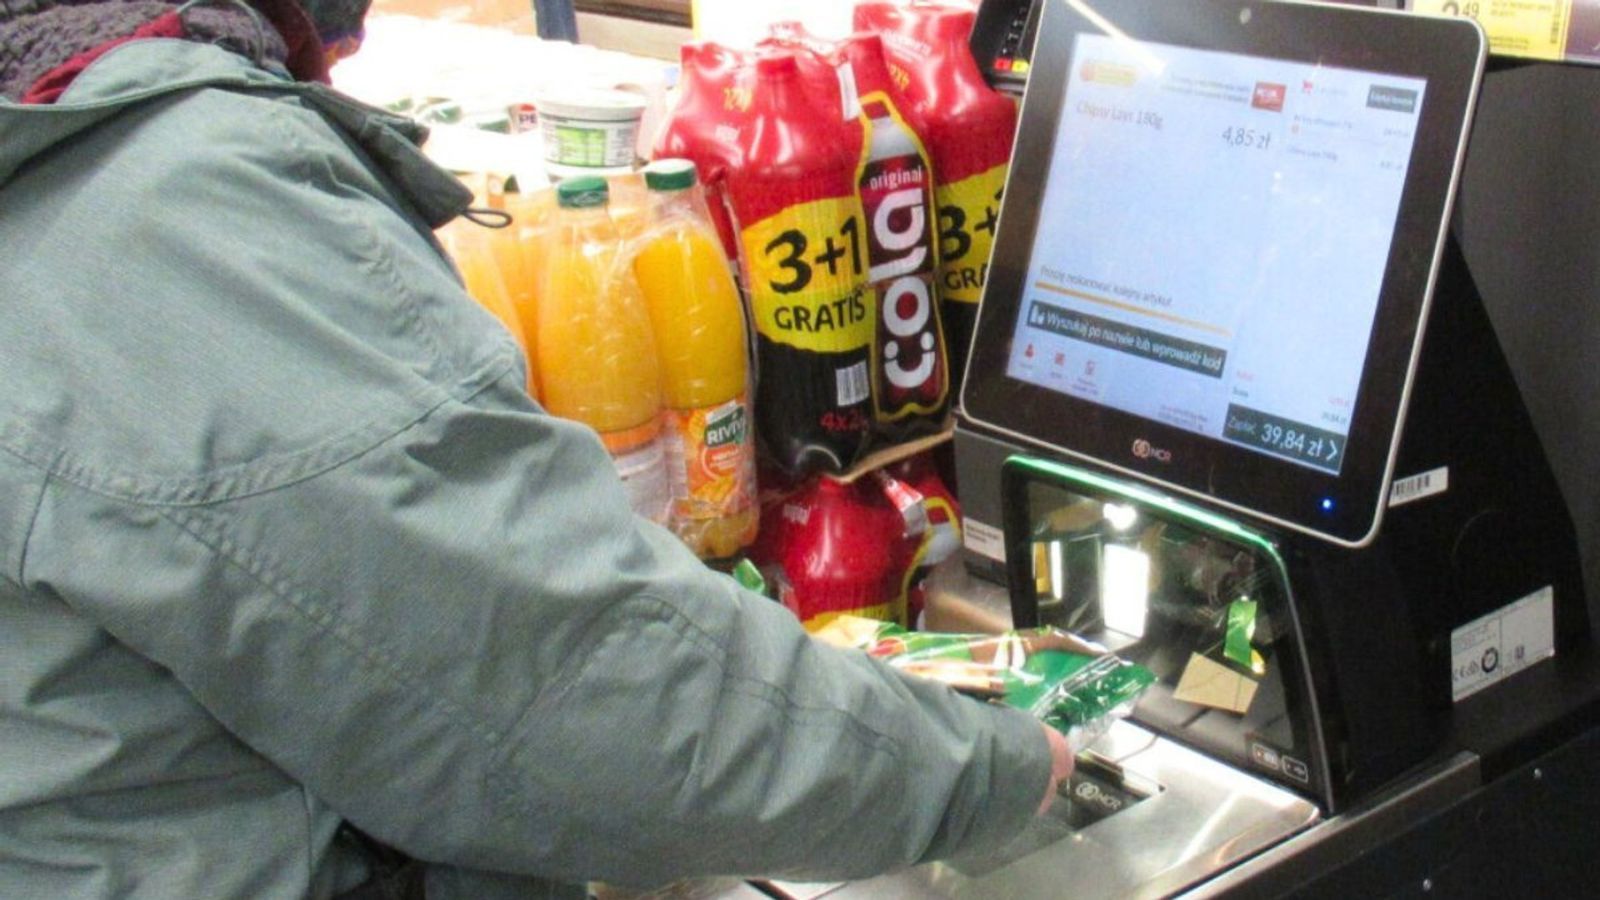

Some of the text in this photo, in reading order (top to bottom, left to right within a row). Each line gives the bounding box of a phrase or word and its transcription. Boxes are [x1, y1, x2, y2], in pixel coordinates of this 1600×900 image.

[1222, 125, 1271, 151] 4,85 zł
[869, 165, 923, 191] original
[940, 187, 1004, 263] 3+
[764, 215, 864, 295] 3+1
[773, 288, 867, 331] GRATIS
[1047, 310, 1088, 337] Wyszukaj
[1088, 325, 1101, 339] po
[1135, 334, 1150, 352] lub
[1202, 353, 1222, 371] kod
[1261, 423, 1306, 451] 39,84
[1307, 438, 1324, 458] zł
